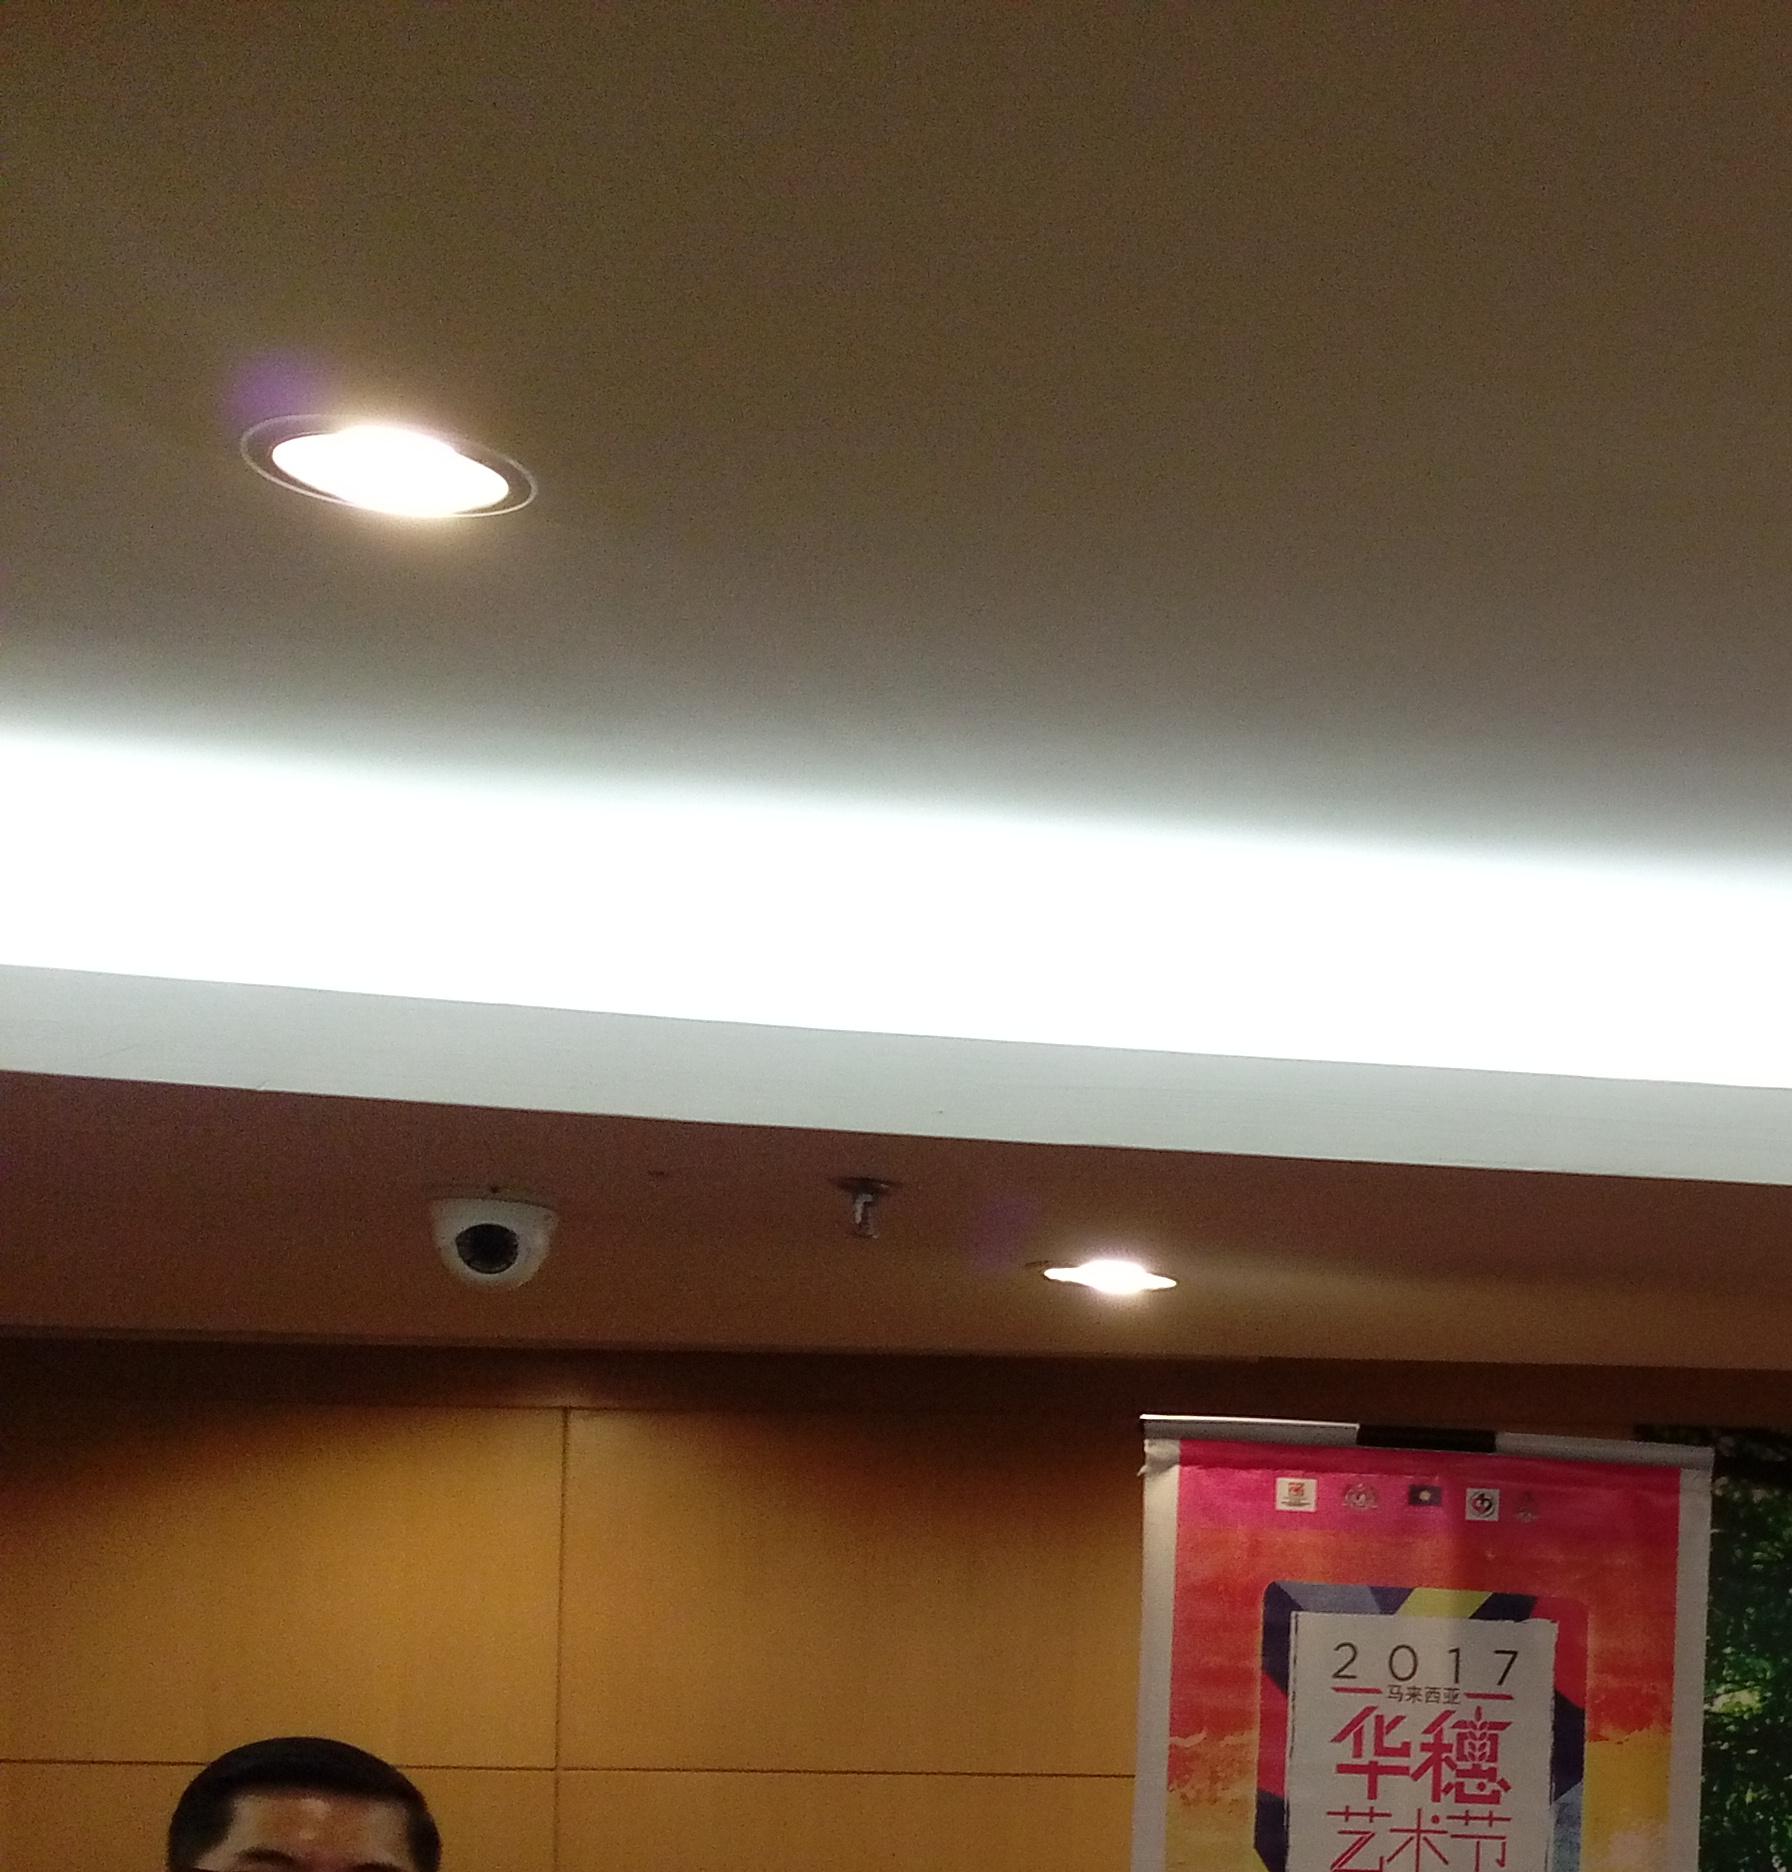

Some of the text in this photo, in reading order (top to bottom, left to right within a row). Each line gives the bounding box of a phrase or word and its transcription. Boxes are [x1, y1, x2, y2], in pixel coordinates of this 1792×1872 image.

[1387, 1684, 1461, 1704] 马来西亚
[1330, 1704, 1513, 1804] 华穗
